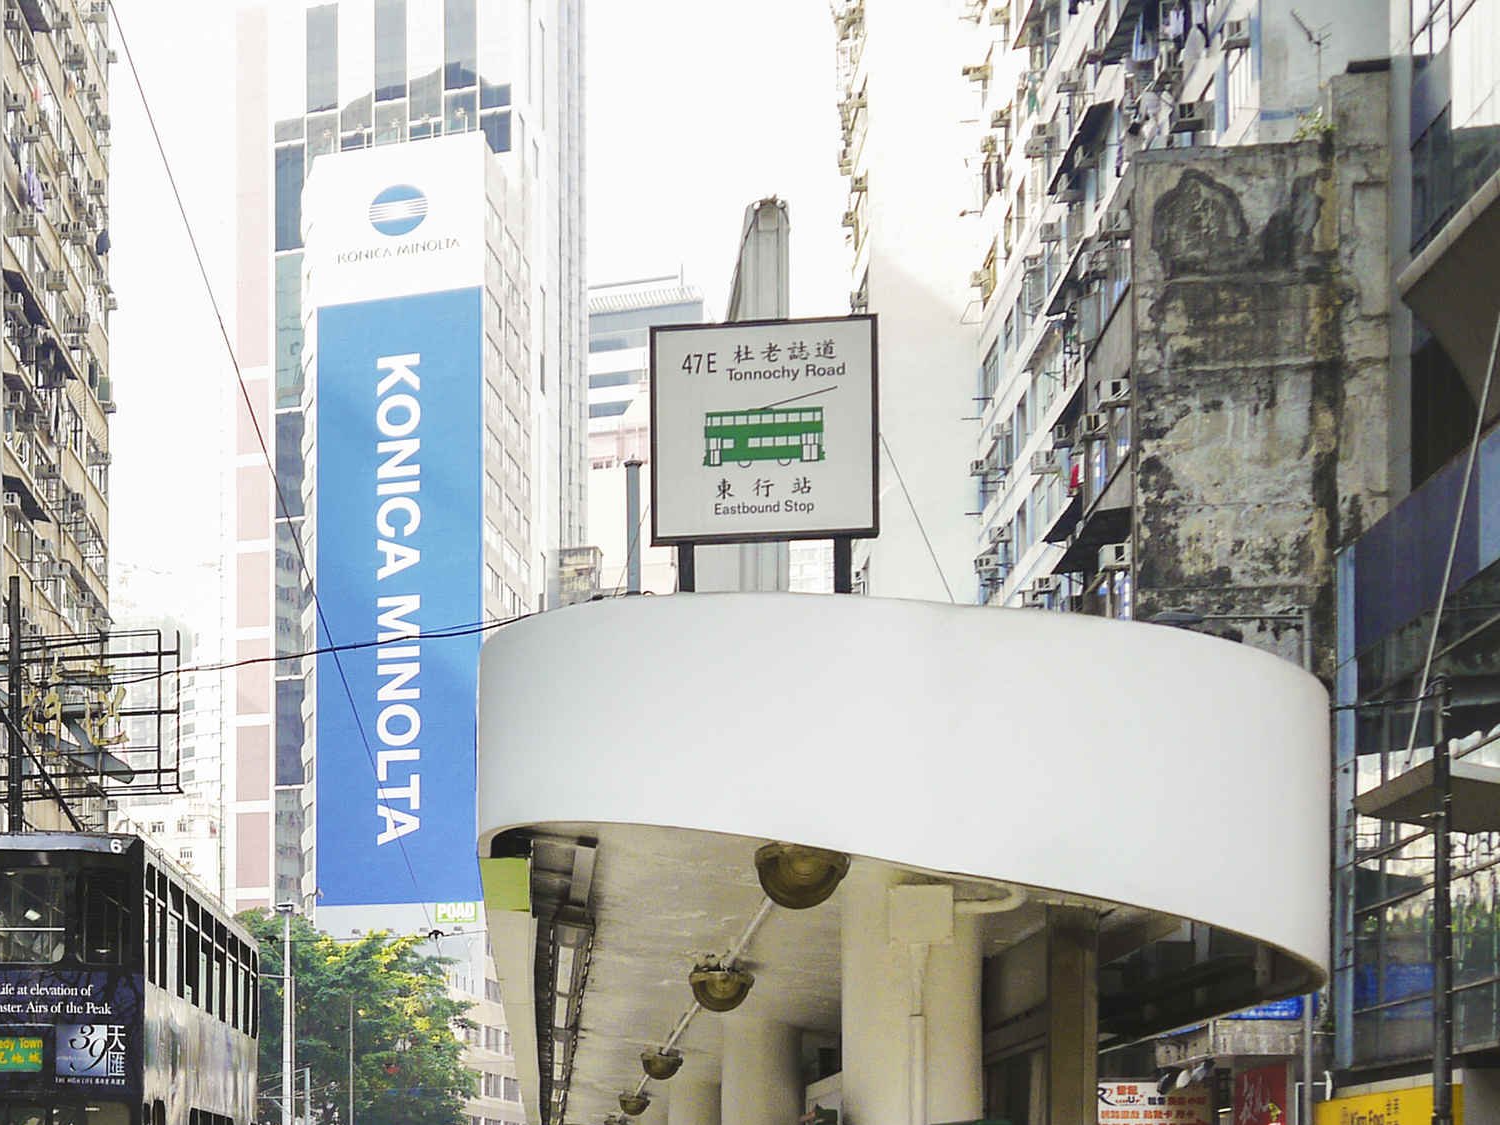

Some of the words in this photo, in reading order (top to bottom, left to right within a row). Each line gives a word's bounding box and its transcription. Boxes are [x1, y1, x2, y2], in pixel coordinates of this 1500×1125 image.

[336, 247, 393, 265] KONICA
[732, 339, 837, 364] 杜老誌道
[726, 365, 801, 382] Tonnochy
[805, 363, 846, 378] Road
[375, 351, 422, 582] KONICA
[715, 477, 813, 500] 東行站
[713, 501, 781, 516] Eastbound
[784, 499, 816, 515] Stop
[375, 593, 422, 847] MINOLTA
[109, 838, 123, 854] 6
[16, 985, 28, 996] at
[29, 983, 78, 996] elevation
[80, 984, 94, 997] of
[25, 1000, 49, 1014] Airs
[50, 1001, 64, 1014] of
[65, 1001, 84, 1014] the
[85, 1001, 112, 1015] Peak
[18, 1037, 44, 1049] Town
[107, 1024, 126, 1077] 天匯
